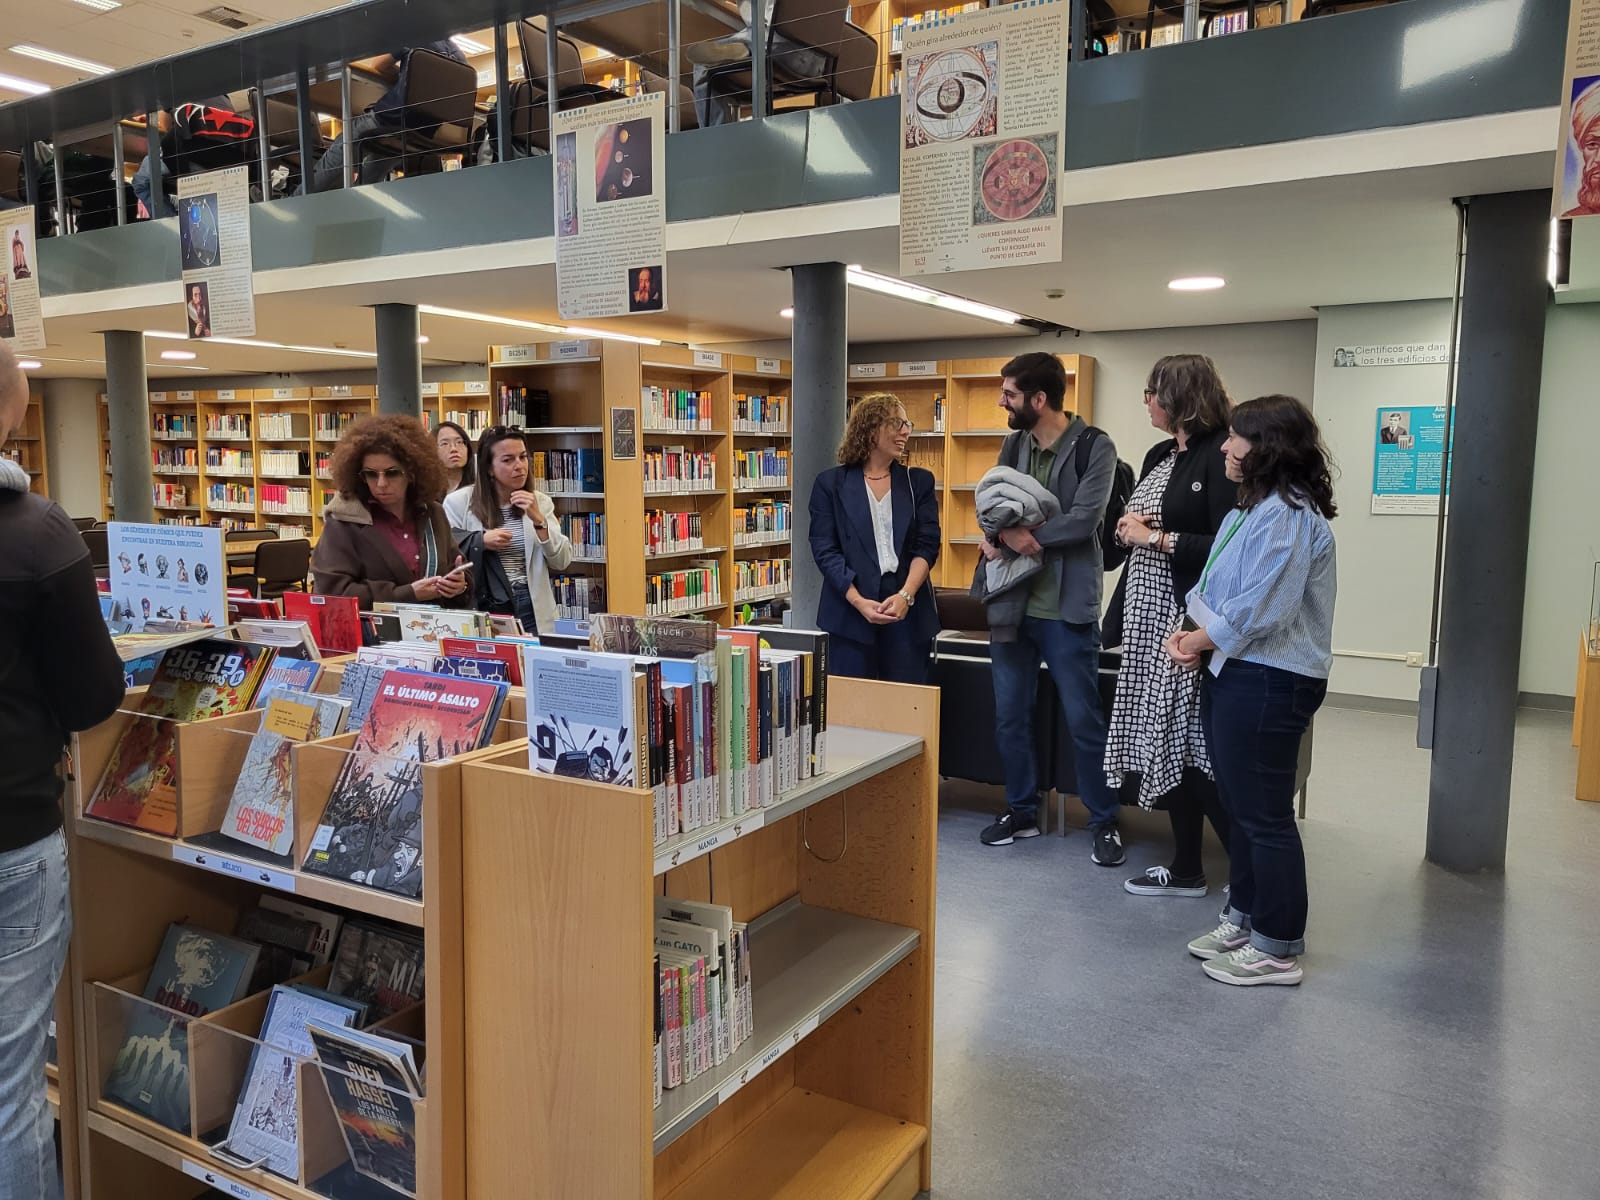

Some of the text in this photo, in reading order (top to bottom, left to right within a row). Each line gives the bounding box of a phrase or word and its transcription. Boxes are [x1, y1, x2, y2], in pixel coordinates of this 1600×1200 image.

[1406, 344, 1425, 354] que
[1427, 343, 1446, 352] dan
[1361, 356, 1375, 365] los
[1377, 356, 1395, 365] tres
[1397, 354, 1436, 364] edificios
[640, 646, 658, 657] LOS
[383, 684, 480, 709] EL ÚLTIMO ASALTO
[236, 806, 286, 834] LOS SURCOS
[236, 820, 252, 836] DEL
[697, 836, 719, 851] MANGA
[221, 860, 242, 873] BÉLICO
[660, 939, 672, 948] un
[673, 940, 702, 953] GATO
[762, 1047, 780, 1065] MANGA
[346, 1060, 385, 1086] SVEN
[344, 1077, 399, 1111] HASSEL
[230, 1183, 251, 1198] BÉLICO
